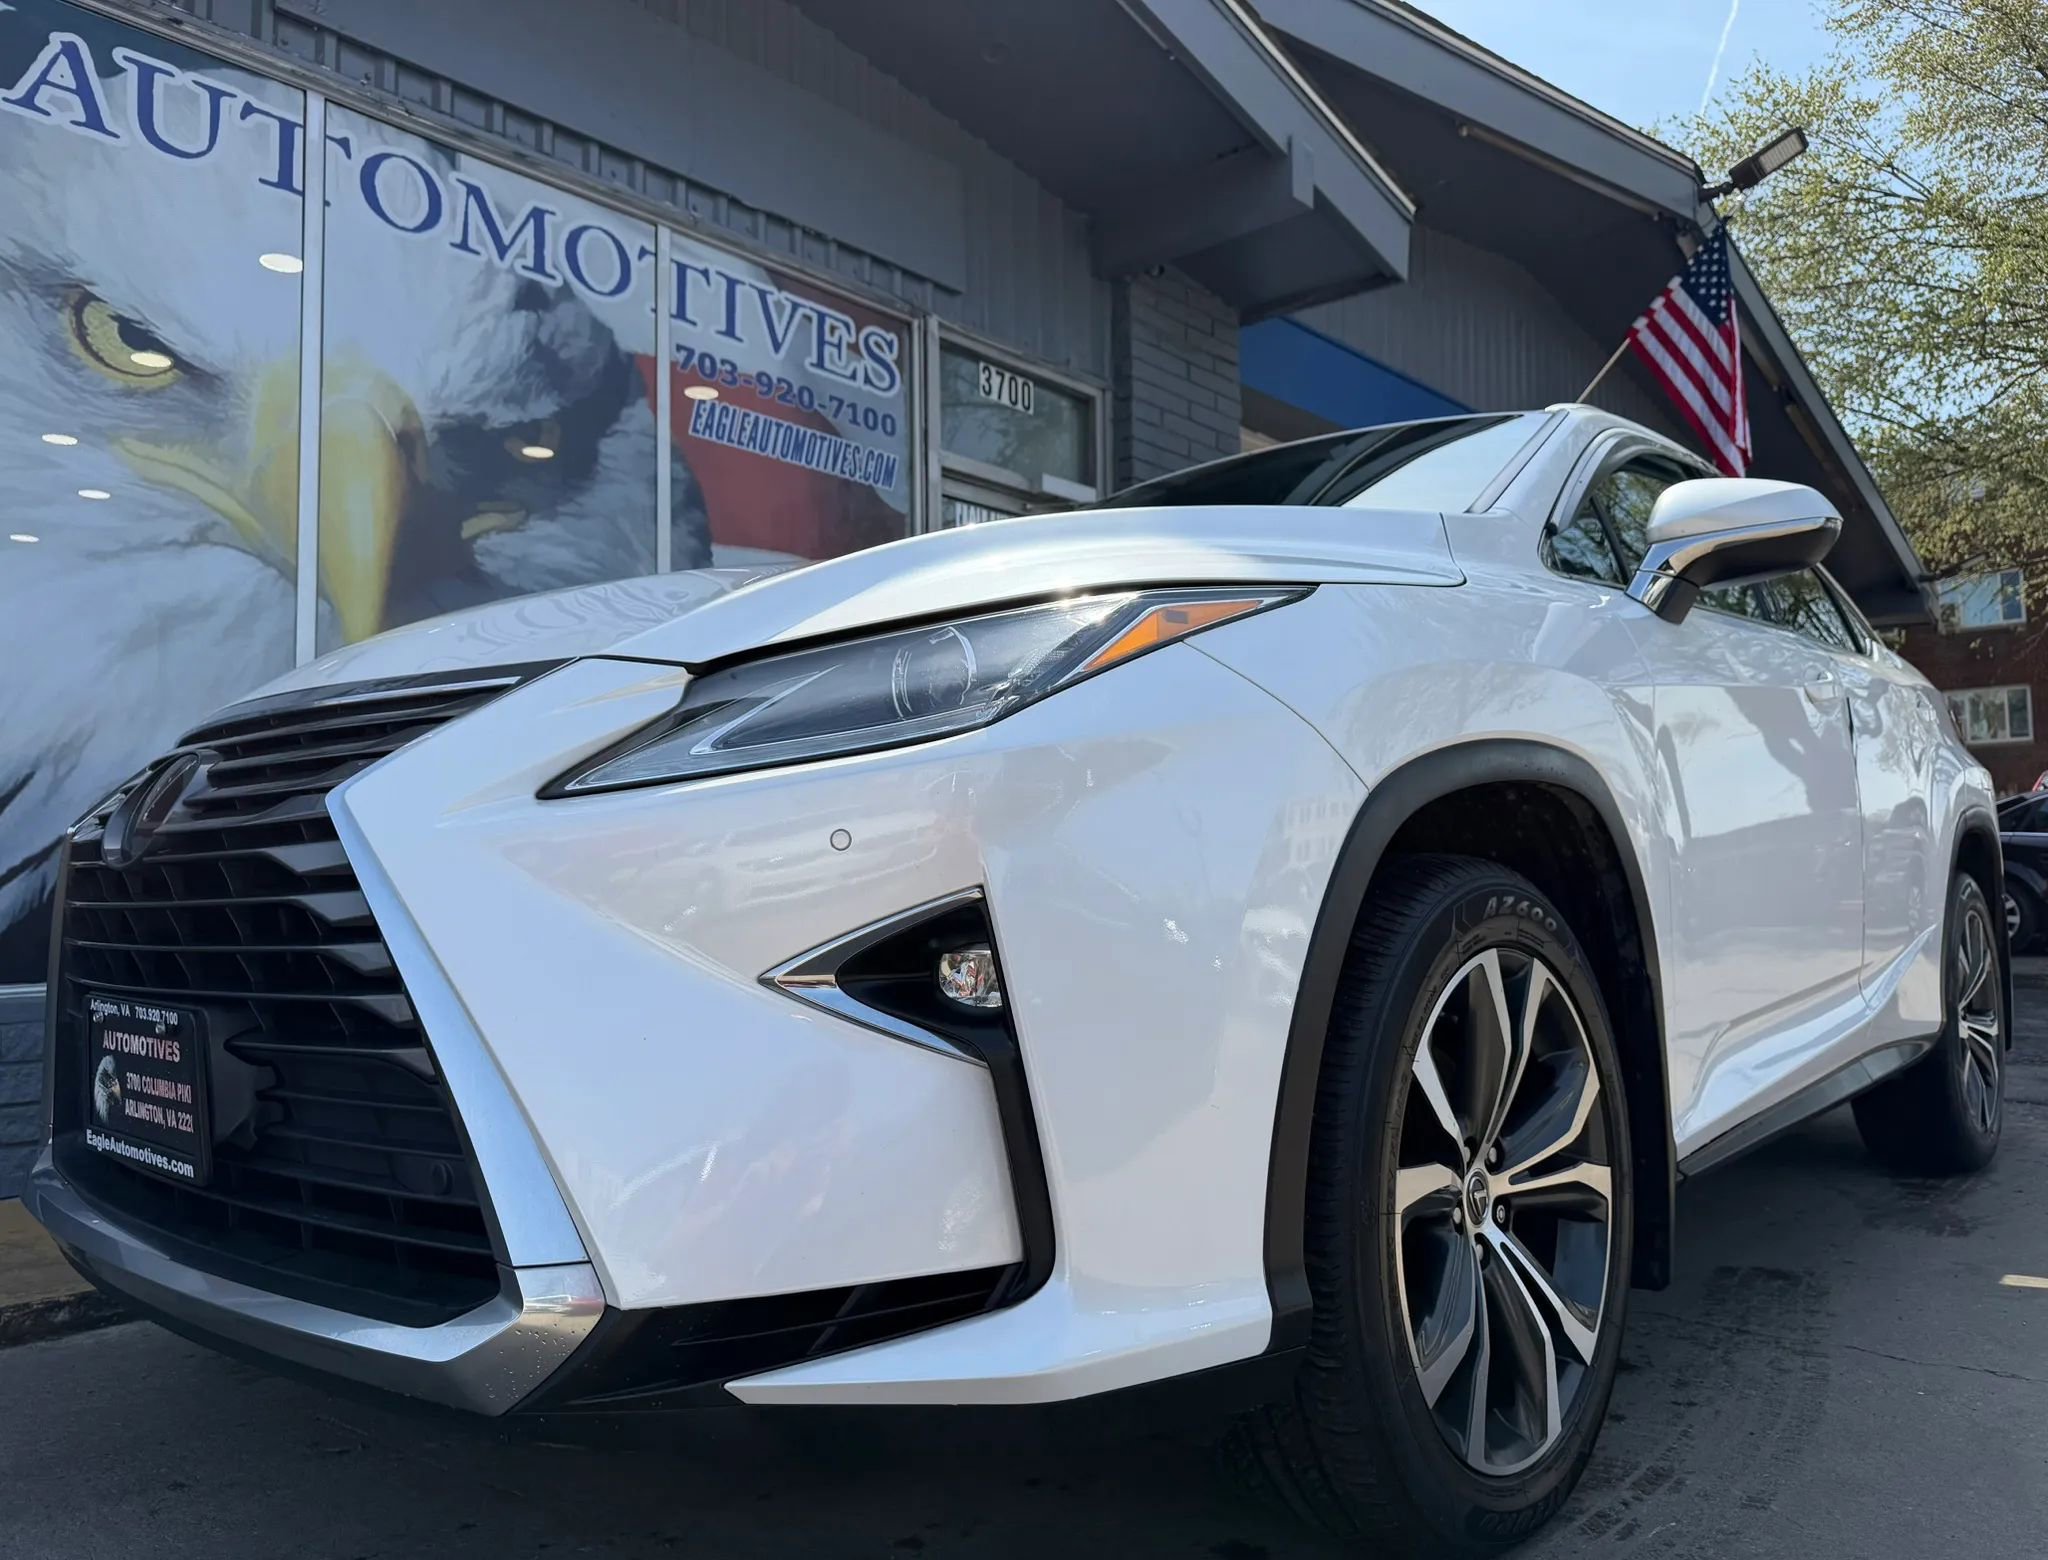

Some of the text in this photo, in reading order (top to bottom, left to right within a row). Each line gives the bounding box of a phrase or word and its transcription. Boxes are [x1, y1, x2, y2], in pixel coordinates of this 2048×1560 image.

[0, 38, 899, 393] AUTOMOTIVES
[676, 343, 897, 437] 703-920-7100
[981, 364, 1032, 412] 3700
[691, 400, 897, 489] EAGLEAUTOMOTIVES.COM
[1482, 895, 1558, 932] AZ600
[89, 998, 179, 1026] Arlington, VA 703.920.7100
[102, 1029, 180, 1063] AUTOMOTIVES
[126, 1071, 141, 1093] 3700
[141, 1075, 177, 1101] COLUMBIA
[125, 1098, 166, 1129] ARLINGTON,
[166, 1108, 177, 1129] VA
[86, 1128, 195, 1179] EagleAutomotives.com
